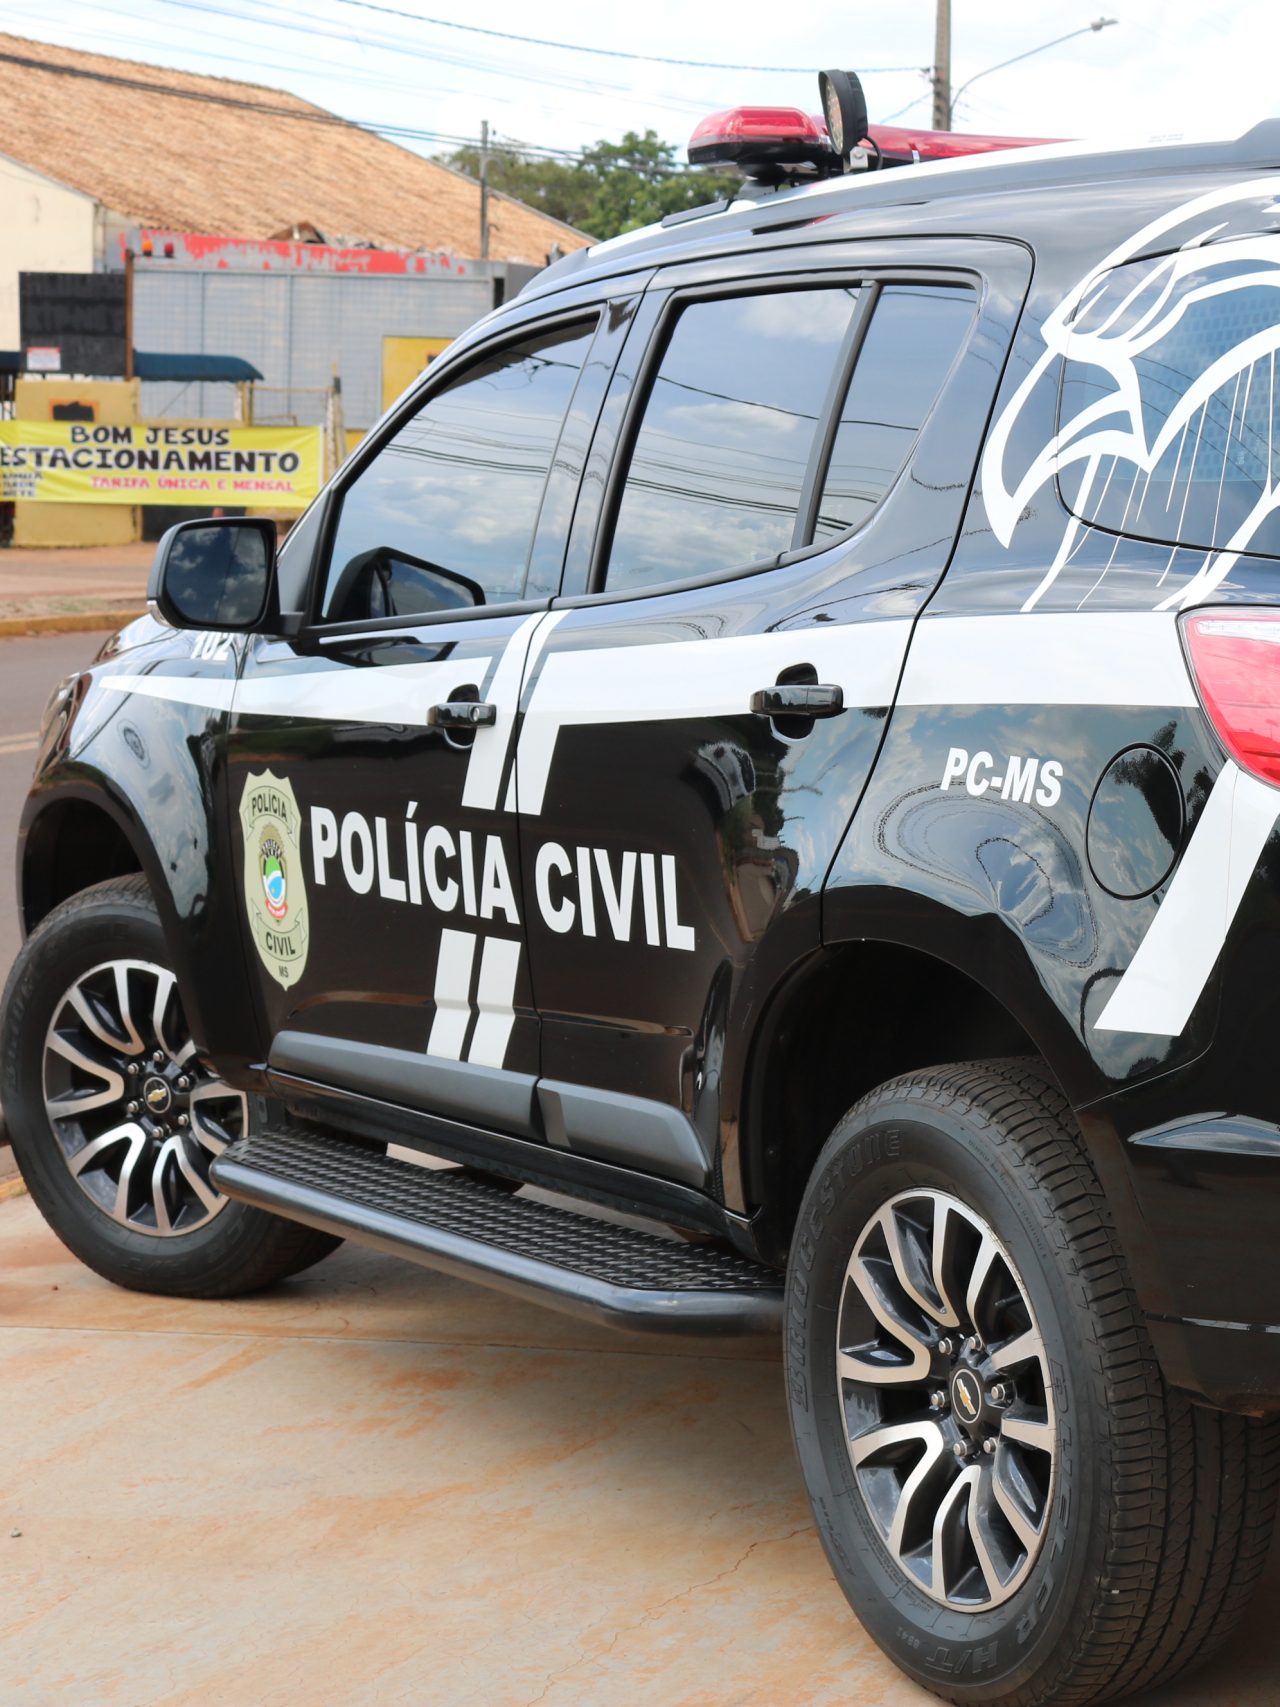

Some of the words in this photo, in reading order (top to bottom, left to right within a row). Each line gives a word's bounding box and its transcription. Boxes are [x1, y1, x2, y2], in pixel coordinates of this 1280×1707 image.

[71, 426, 132, 444] BOM
[146, 428, 230, 445] JESUS
[0, 447, 300, 473] ESTACIONAMENTO
[91, 476, 150, 490] TARIFA
[158, 475, 210, 491] ÚNICA
[217, 479, 226, 490] E
[233, 480, 295, 493] MENSAL
[940, 747, 1064, 808] PC-MS
[252, 788, 287, 822] POLÍCIA
[310, 800, 521, 925] POLÍCIA
[535, 841, 696, 952] CIVIL
[265, 931, 296, 956] CIVIL
[278, 965, 289, 978] MS
